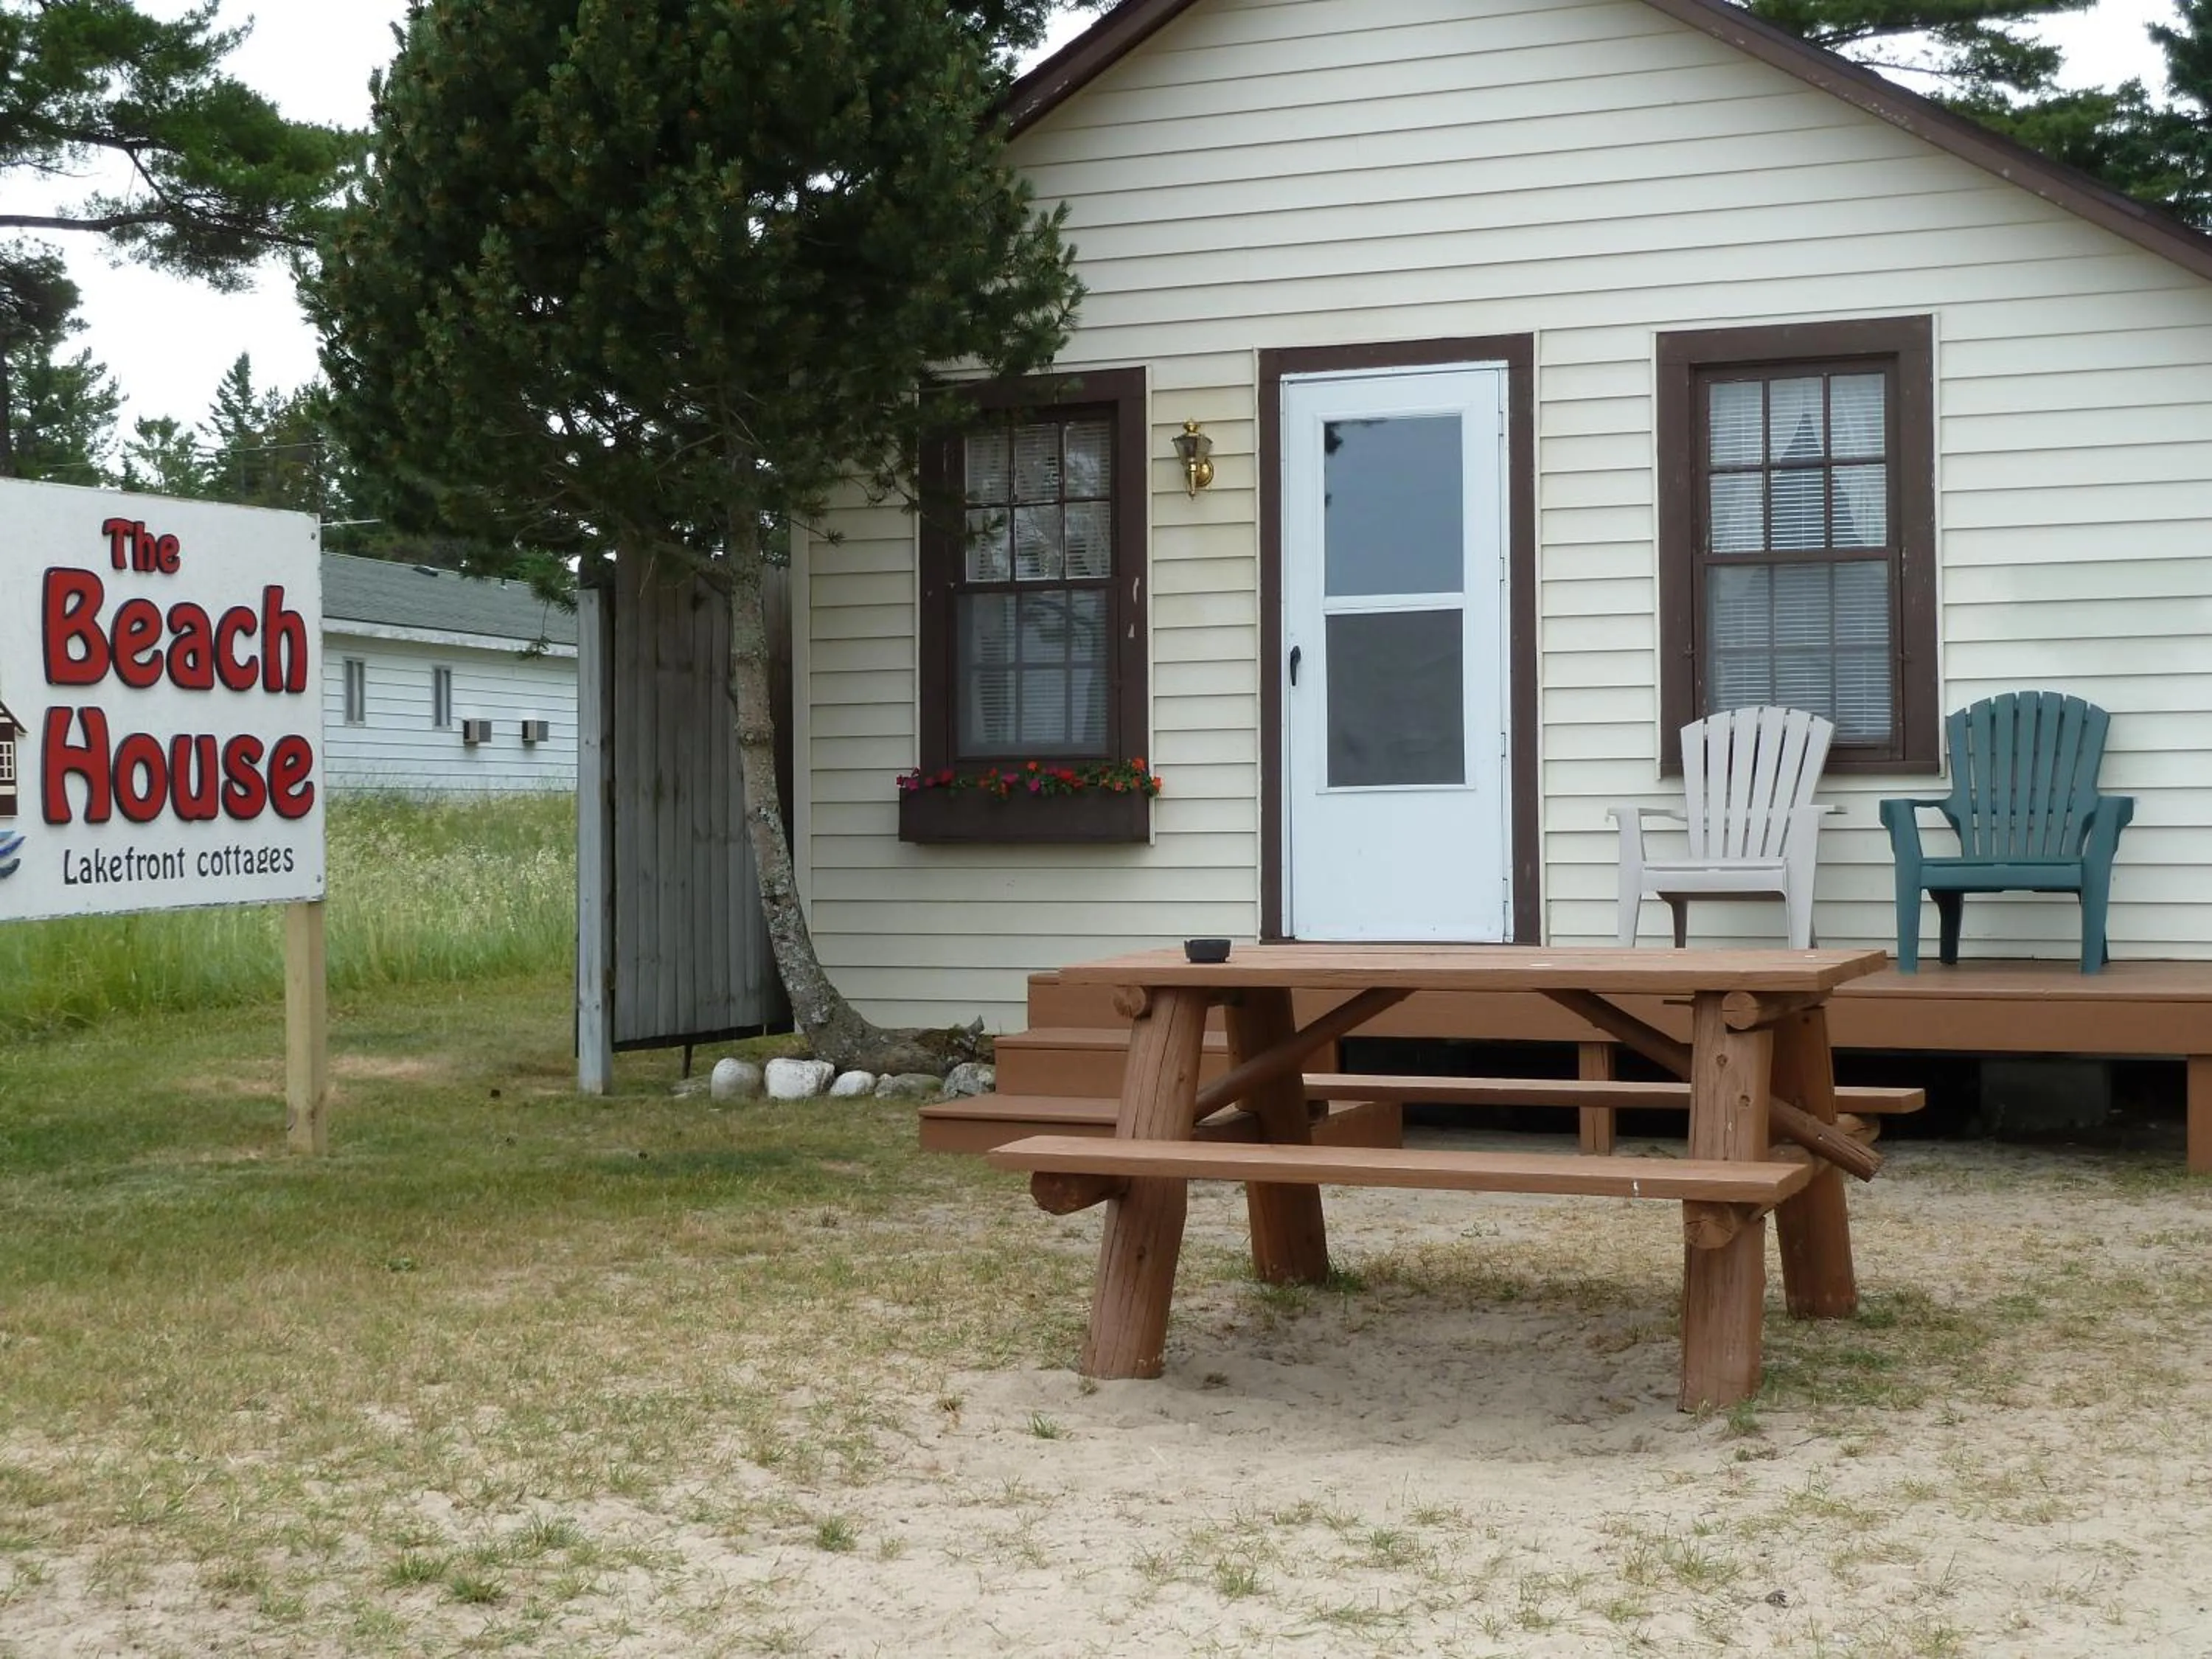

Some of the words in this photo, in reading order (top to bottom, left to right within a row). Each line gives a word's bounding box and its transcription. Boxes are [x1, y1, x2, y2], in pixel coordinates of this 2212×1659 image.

[102, 518, 180, 574] The
[43, 566, 307, 692] Beach
[41, 706, 315, 824] House
[64, 847, 184, 885] Lakefront
[197, 846, 294, 877] cottages
